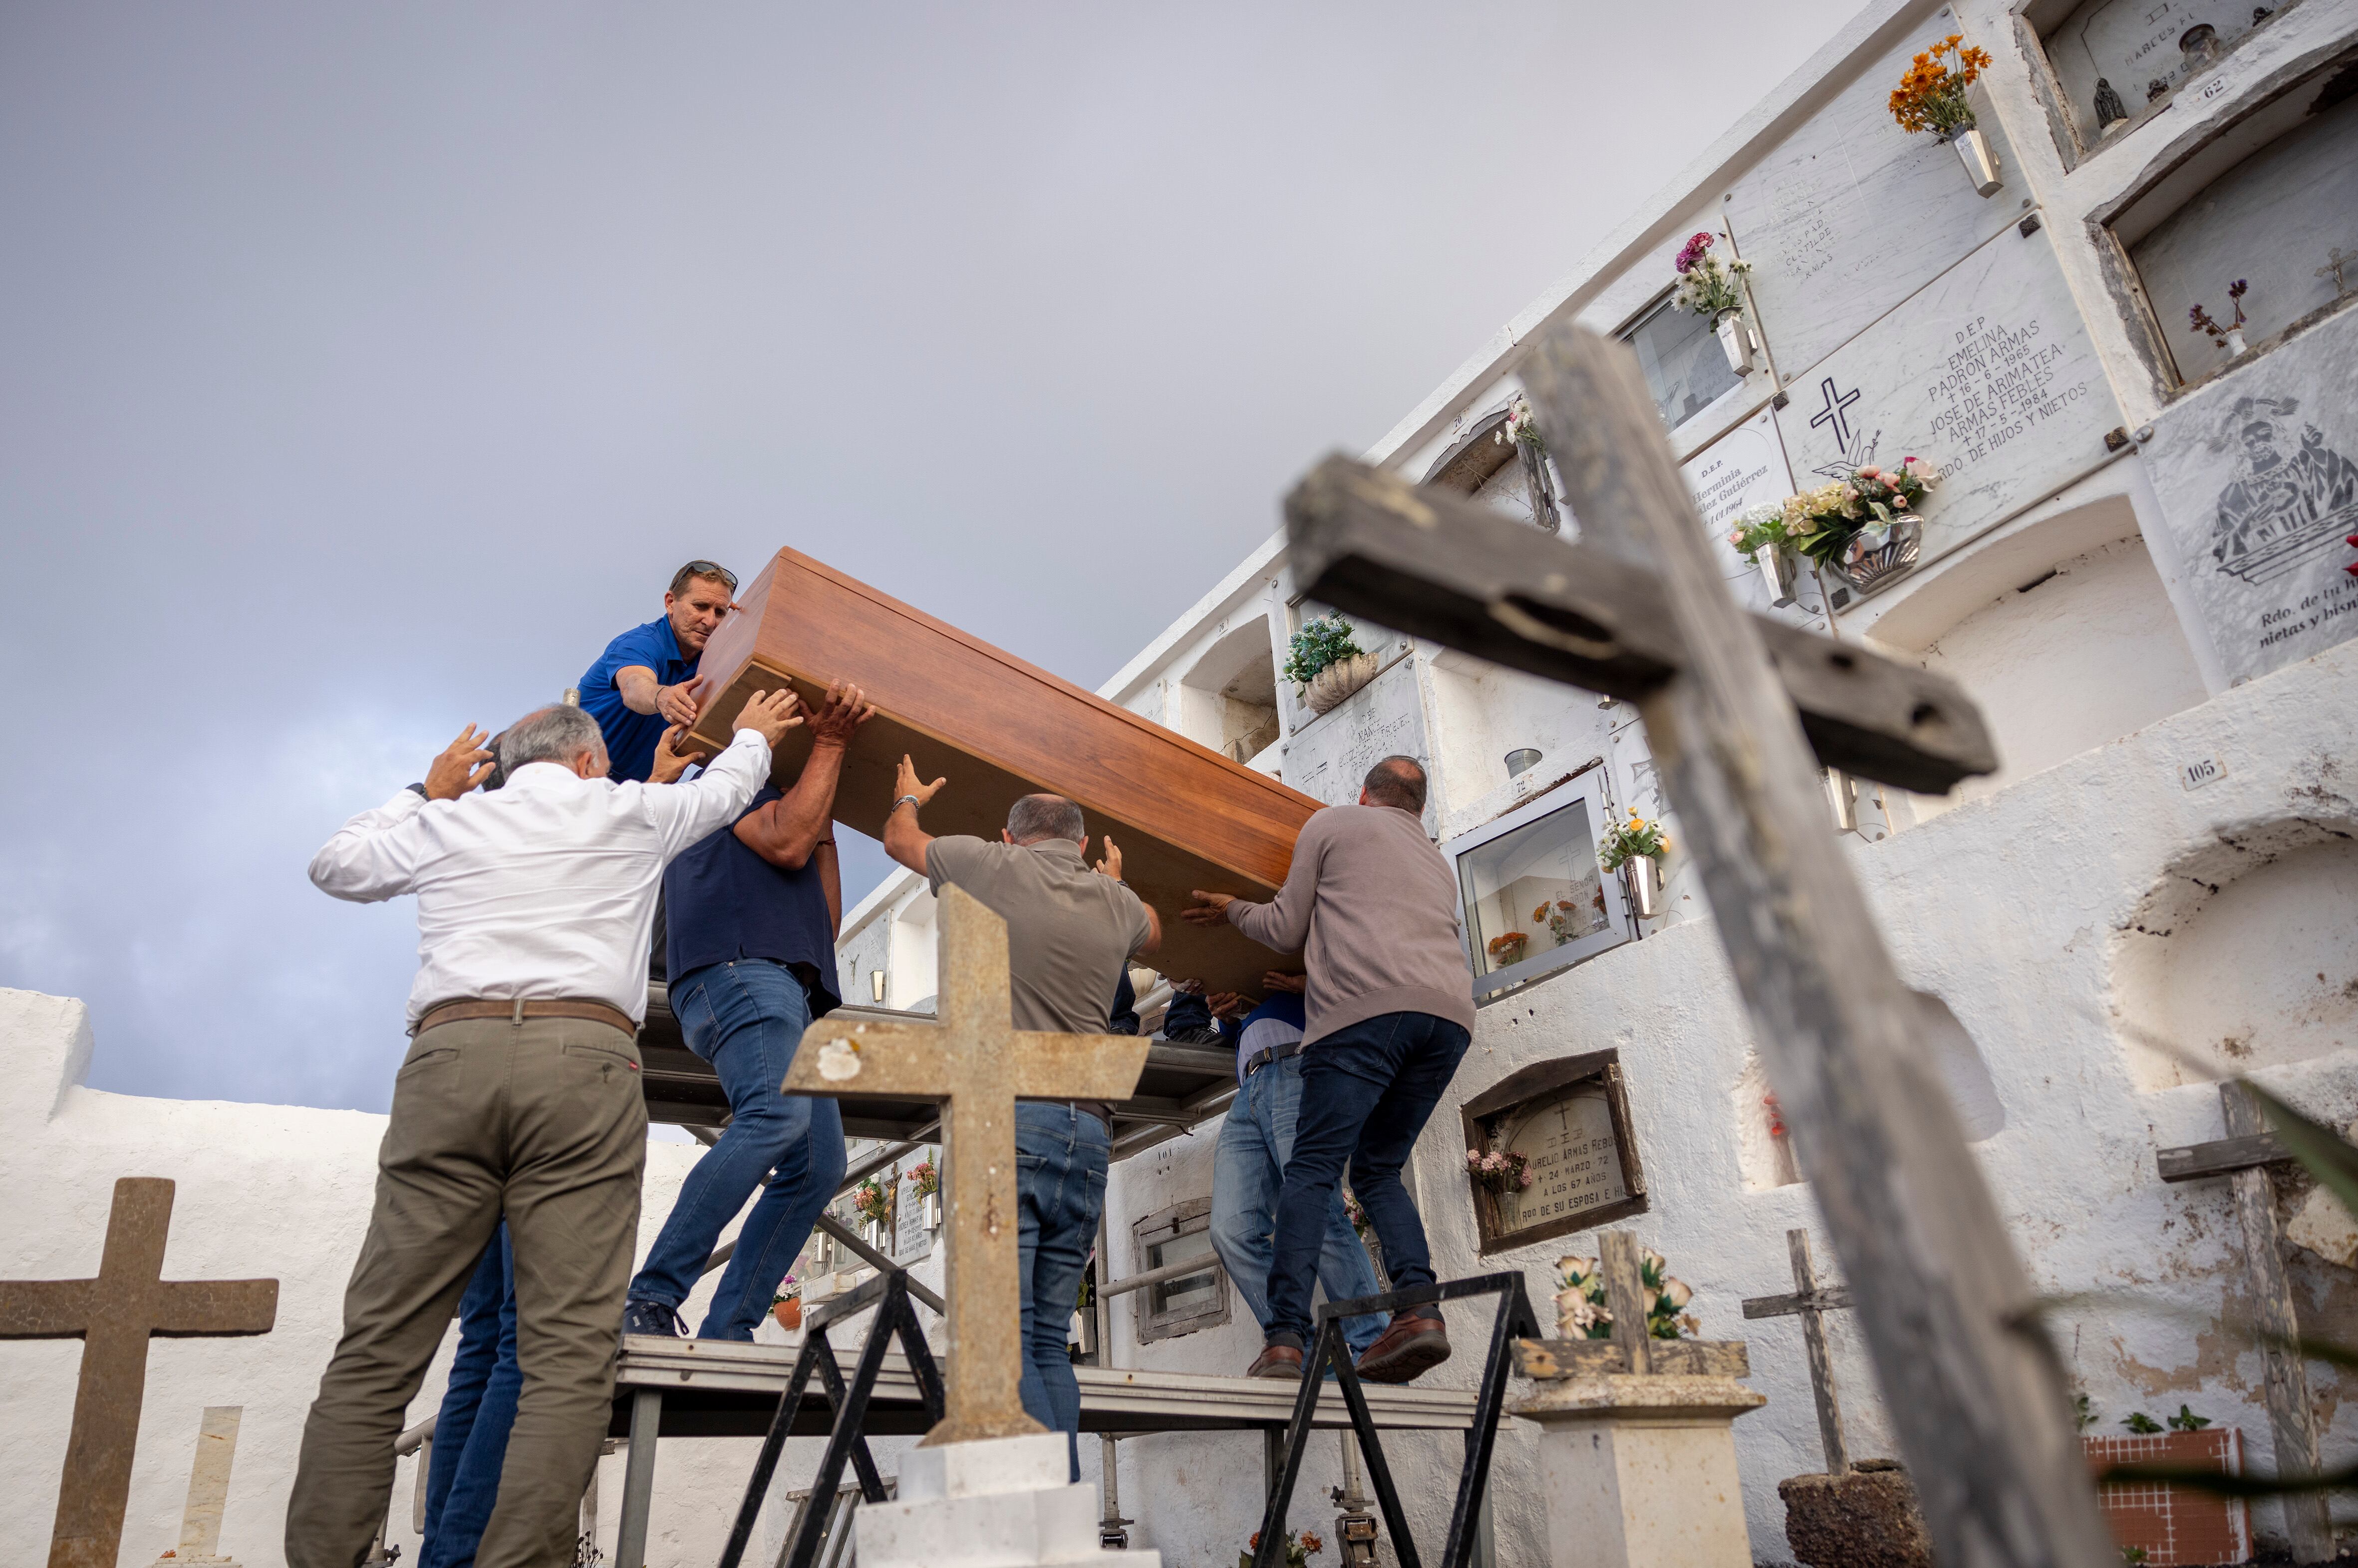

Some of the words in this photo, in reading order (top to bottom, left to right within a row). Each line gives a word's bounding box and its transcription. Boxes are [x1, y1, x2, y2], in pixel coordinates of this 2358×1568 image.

[2124, 25, 2175, 66] MARCOS
[2204, 79, 2224, 98] 62
[1786, 227, 1831, 266] CLOTILDE
[1928, 355, 1987, 402] PADRON
[1990, 319, 2041, 363] ARMAS
[1948, 324, 2008, 371] EMELINA
[1959, 382, 1972, 396] 16
[2004, 344, 2031, 367] 1965
[1930, 404, 1963, 435] JOSE
[1964, 391, 1985, 413] DE
[1987, 343, 2063, 396] ARIMATEA
[1950, 401, 1997, 442] ARMAS
[1999, 365, 2054, 410] FEBLES
[1455, 416, 1462, 428] 70
[1969, 443, 1988, 463] DE
[1988, 421, 2024, 451] HIJOS
[2025, 412, 2036, 426] Y
[2038, 381, 2088, 418] NIETOS
[1975, 426, 1986, 440] 17
[2021, 388, 2049, 412] 1984
[1701, 460, 1724, 478] D.E.P.
[1719, 465, 1768, 501] Gutiérrez
[1692, 468, 1743, 505] Herminia
[2261, 607, 2296, 628] Rdo.
[2301, 594, 2320, 611] de
[2260, 621, 2306, 649] nietas
[2309, 614, 2320, 631] y
[1338, 739, 1372, 768] GONZALEZ
[1373, 712, 1411, 744] RODRIGUEZ
[1357, 718, 1385, 744] MANUEL
[1516, 780, 1525, 793] 72
[2187, 759, 2216, 783] 105
[1556, 890, 1566, 900] EL
[1158, 1147, 1172, 1160] 101
[1549, 1170, 1559, 1181] 24
[1565, 1161, 1591, 1175] MARZO
[1598, 1155, 1609, 1167] 72
[1563, 1144, 1589, 1162] ARMAS
[1544, 1188, 1549, 1197] A
[1552, 1183, 1567, 1195] LOS
[1571, 1179, 1581, 1189] 67
[1585, 1172, 1607, 1186] AÑOS
[1540, 1205, 1550, 1216] DE
[1554, 1201, 1564, 1213] SU
[1569, 1193, 1600, 1209] ESPOSA
[1604, 1189, 1610, 1200] E
